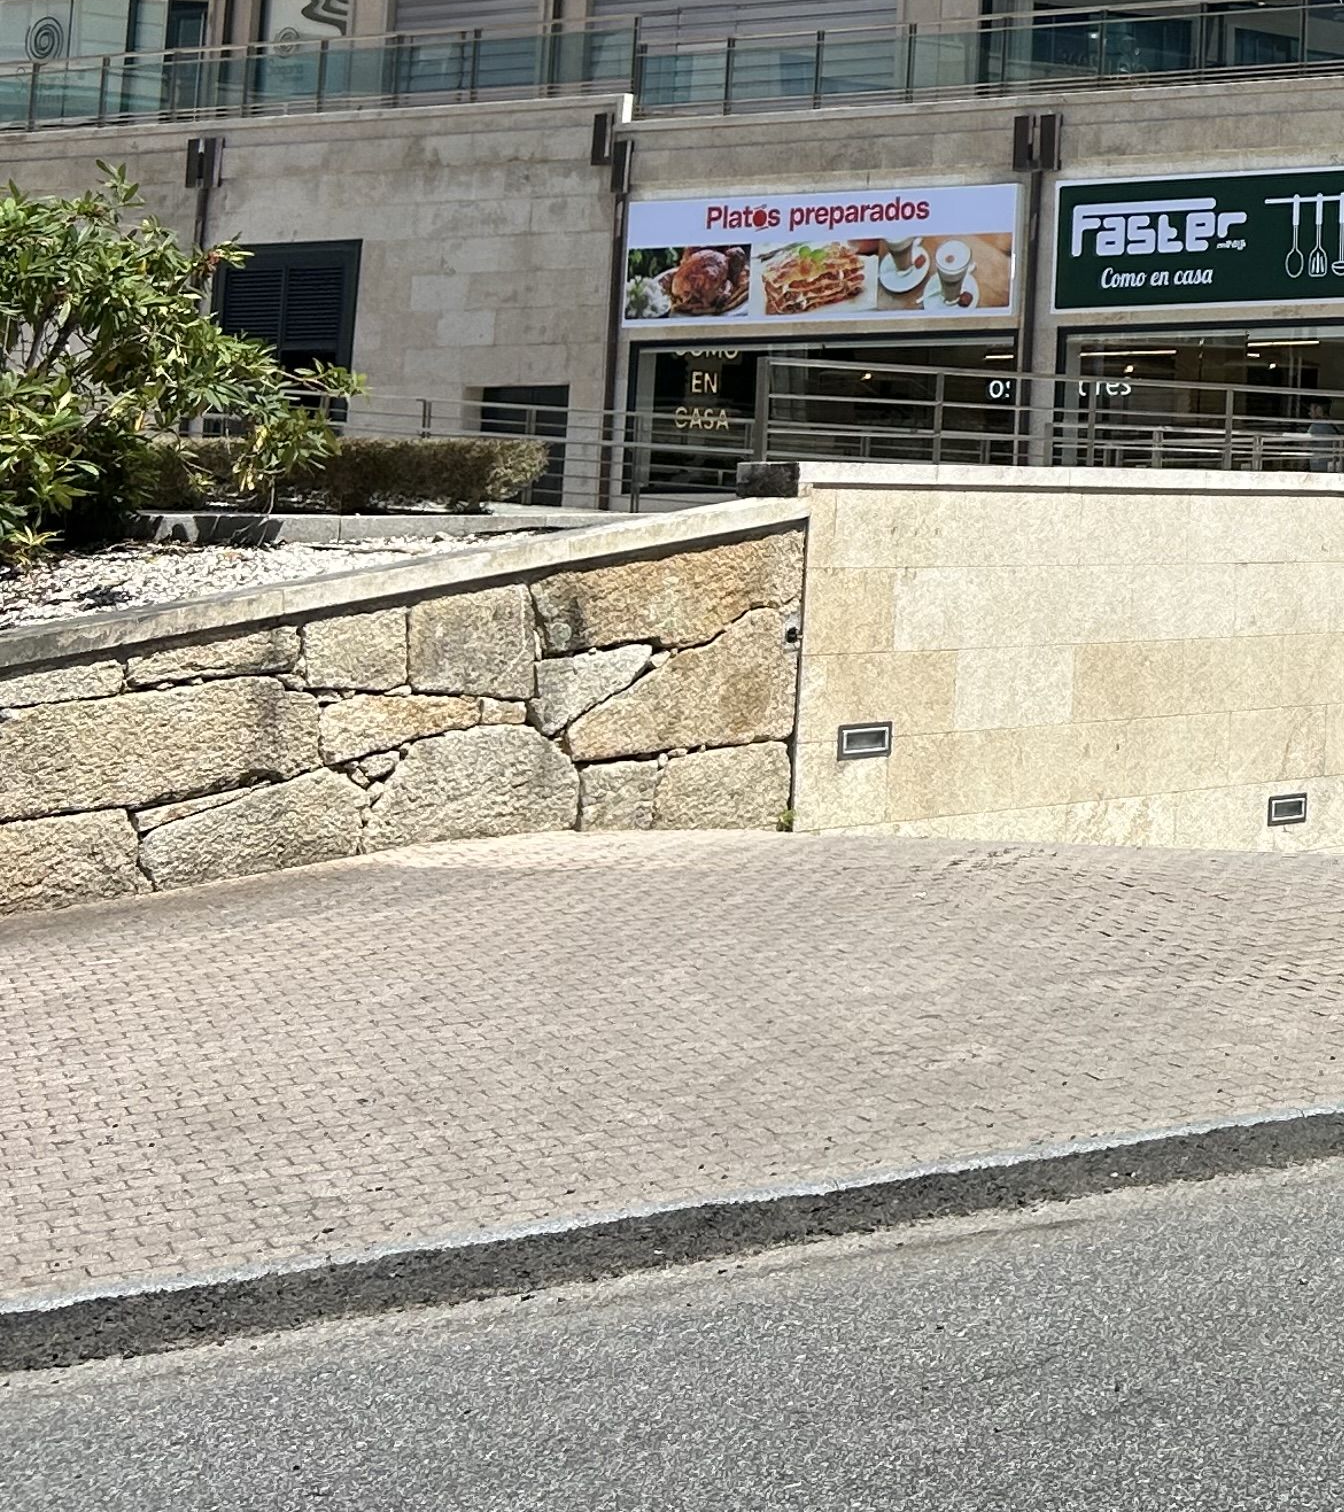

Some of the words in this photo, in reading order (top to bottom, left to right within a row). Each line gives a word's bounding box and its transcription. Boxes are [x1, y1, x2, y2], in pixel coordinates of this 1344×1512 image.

[706, 204, 781, 231] Platos
[789, 197, 930, 231] preparados
[1071, 197, 1247, 257] Faster
[1100, 267, 1147, 288] Como
[1150, 269, 1170, 286] en
[1174, 268, 1214, 285] casa
[691, 371, 718, 394] EN
[674, 406, 730, 430] CASA
